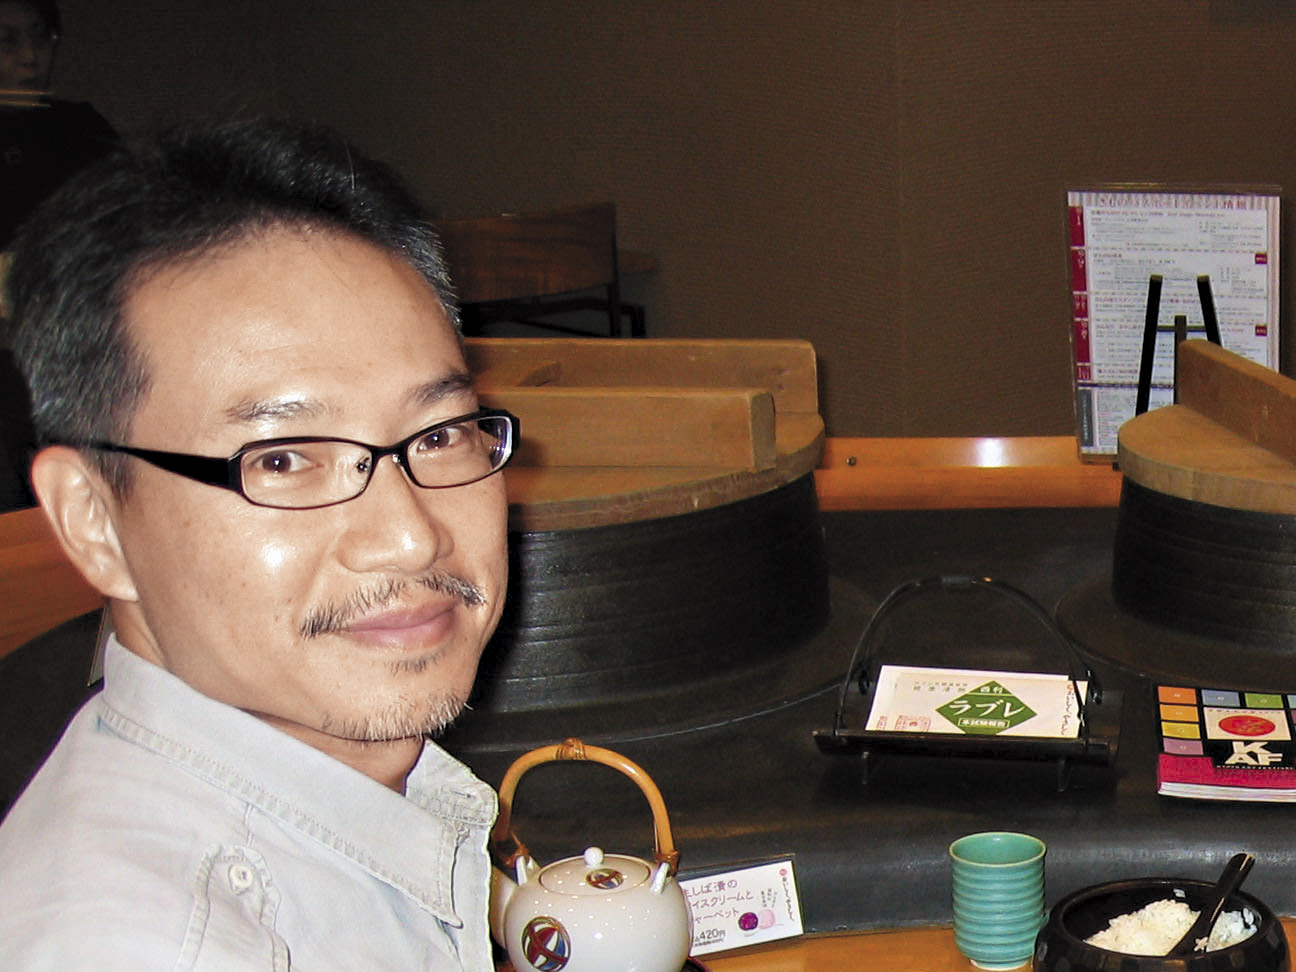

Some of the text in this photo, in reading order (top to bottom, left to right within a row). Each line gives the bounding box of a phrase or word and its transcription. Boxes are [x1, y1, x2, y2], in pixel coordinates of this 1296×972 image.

[949, 699, 1025, 718] ラブレ
[689, 889, 754, 911] イスクリームと
